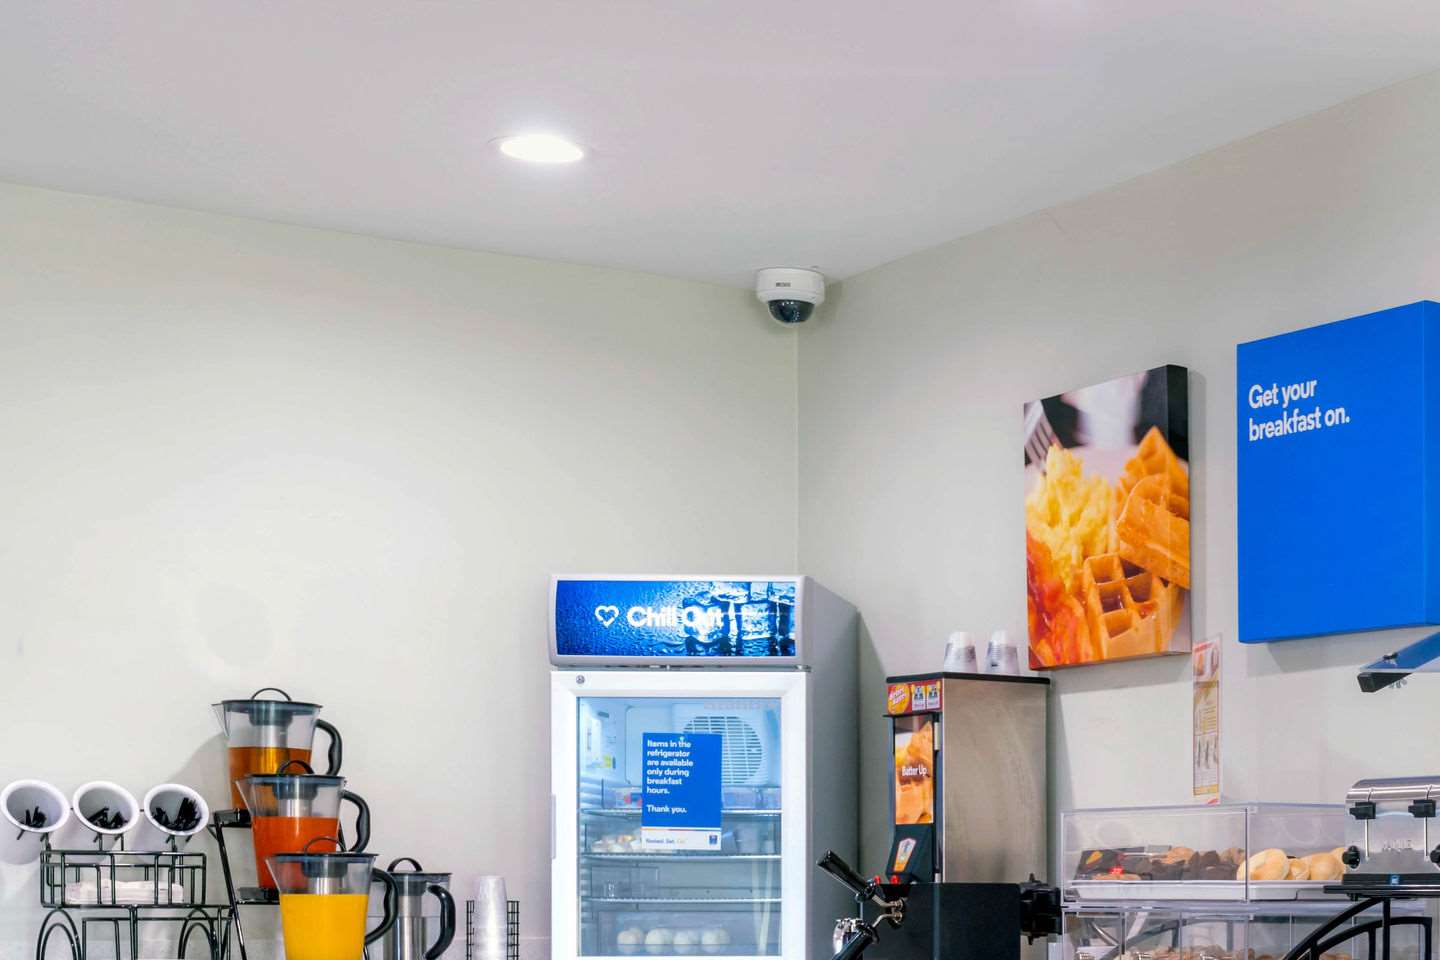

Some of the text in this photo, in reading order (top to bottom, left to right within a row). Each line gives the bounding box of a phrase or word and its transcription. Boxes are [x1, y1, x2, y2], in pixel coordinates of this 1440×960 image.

[1248, 380, 1318, 409] Get your
[1249, 406, 1351, 441] breakfast on.
[627, 606, 678, 628] Chill
[647, 739, 691, 748] Items in the
[647, 749, 690, 758] refrigerator
[661, 759, 694, 767] available
[646, 768, 690, 777] only during
[646, 777, 682, 785] breakfast
[646, 786, 671, 794] hours.
[646, 804, 688, 815] Thank you.
